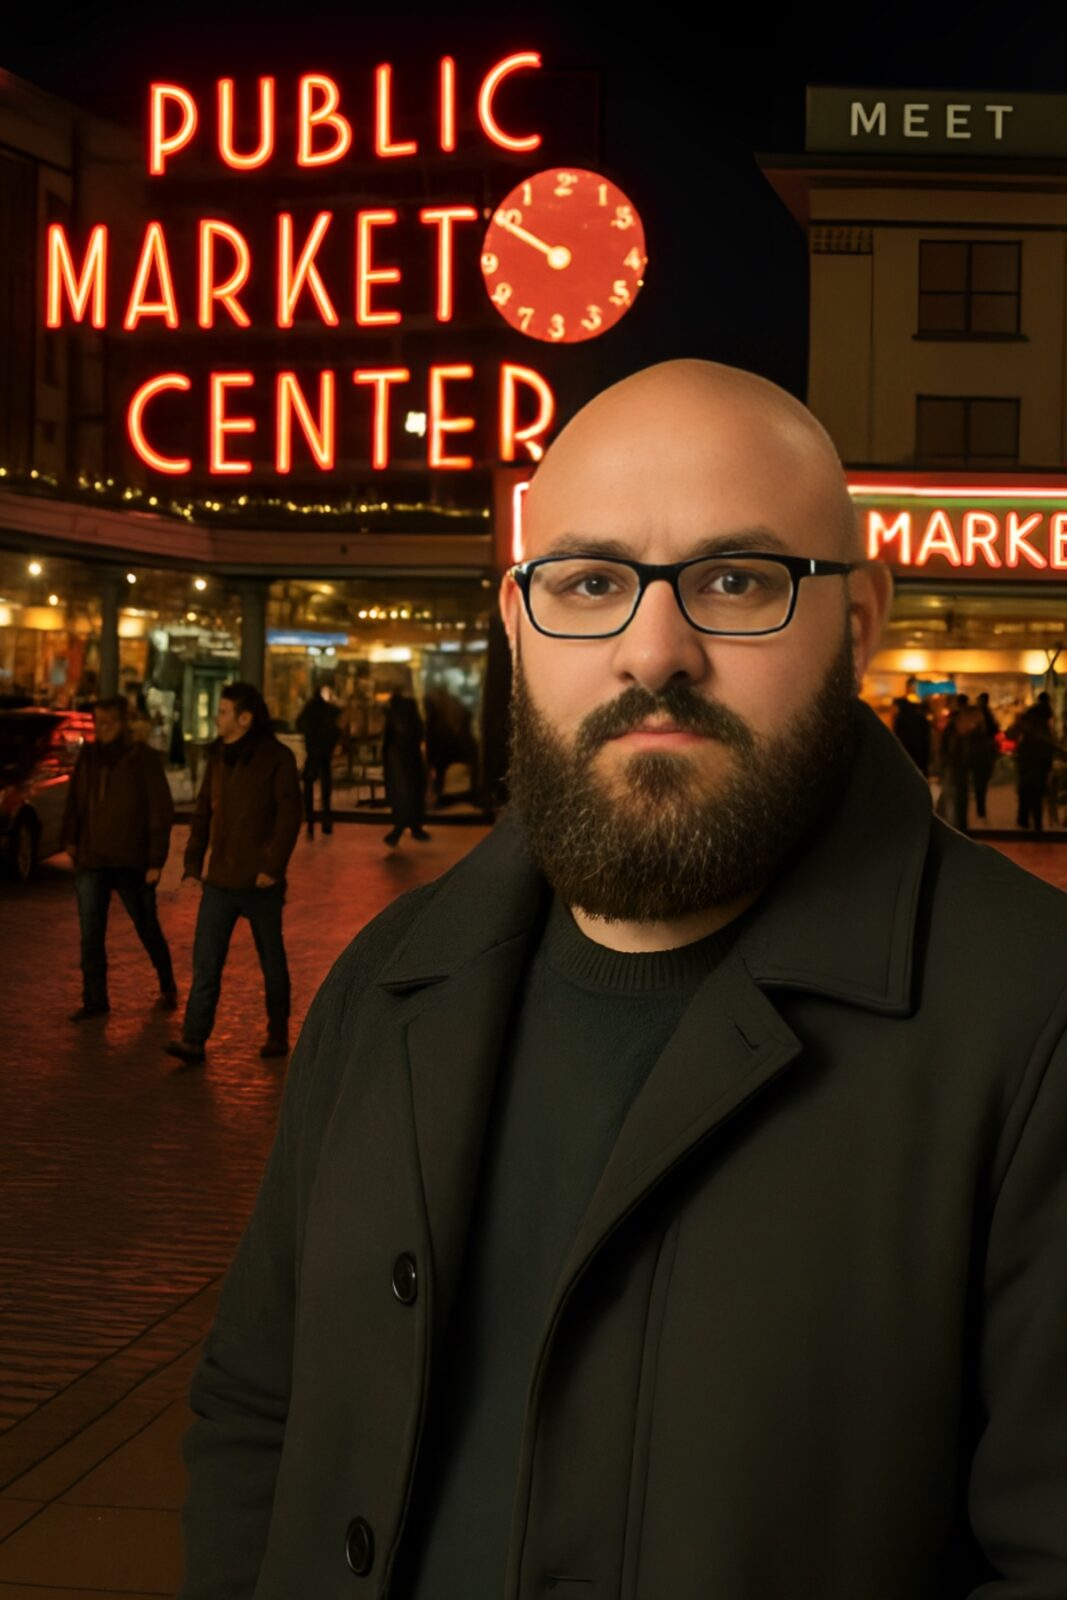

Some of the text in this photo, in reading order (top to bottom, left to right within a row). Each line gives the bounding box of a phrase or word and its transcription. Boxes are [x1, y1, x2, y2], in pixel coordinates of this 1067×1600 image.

[147, 51, 542, 177] PUBLIC
[850, 101, 1013, 140] MEET
[45, 205, 479, 332] MARKET
[127, 362, 555, 476] CENTER
[866, 509, 1067, 570] MARKE
